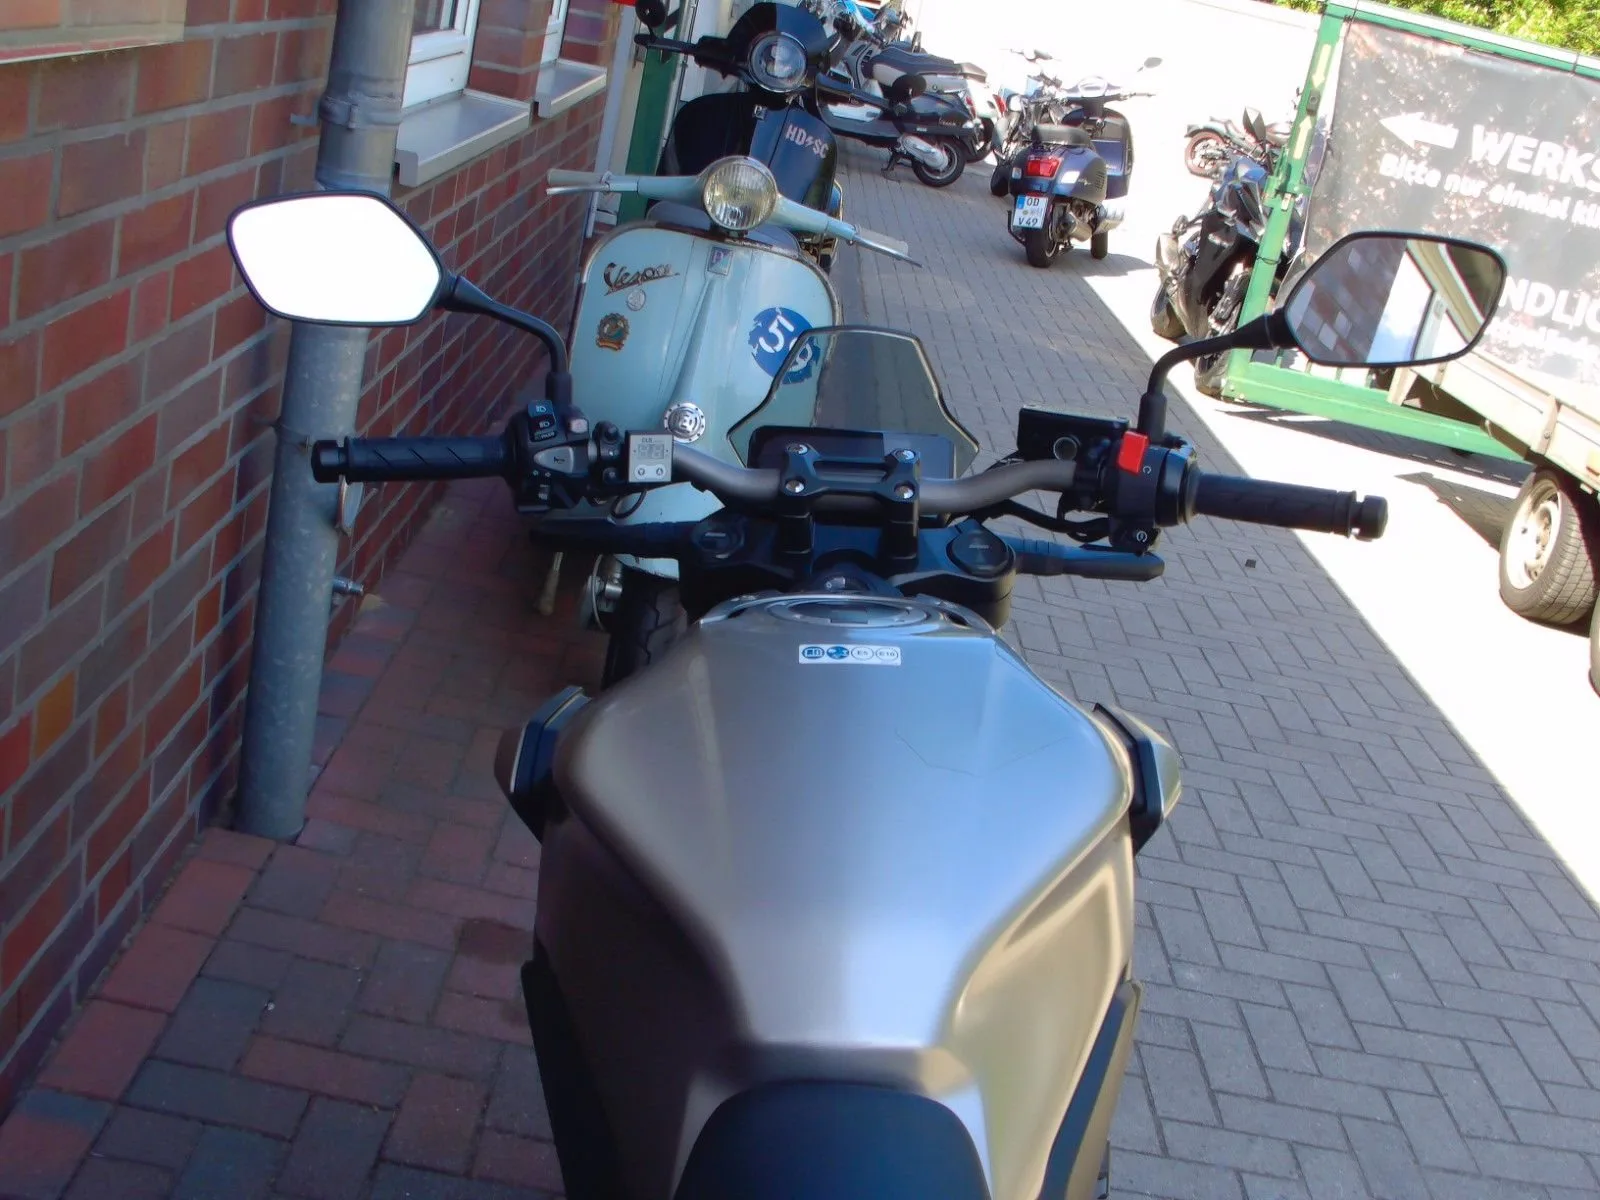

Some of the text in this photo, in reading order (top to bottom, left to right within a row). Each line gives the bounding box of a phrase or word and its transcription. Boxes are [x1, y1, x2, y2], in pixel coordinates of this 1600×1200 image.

[1379, 152, 1441, 188] Bitte
[1444, 173, 1488, 198] nur
[604, 262, 680, 296] Vespa
